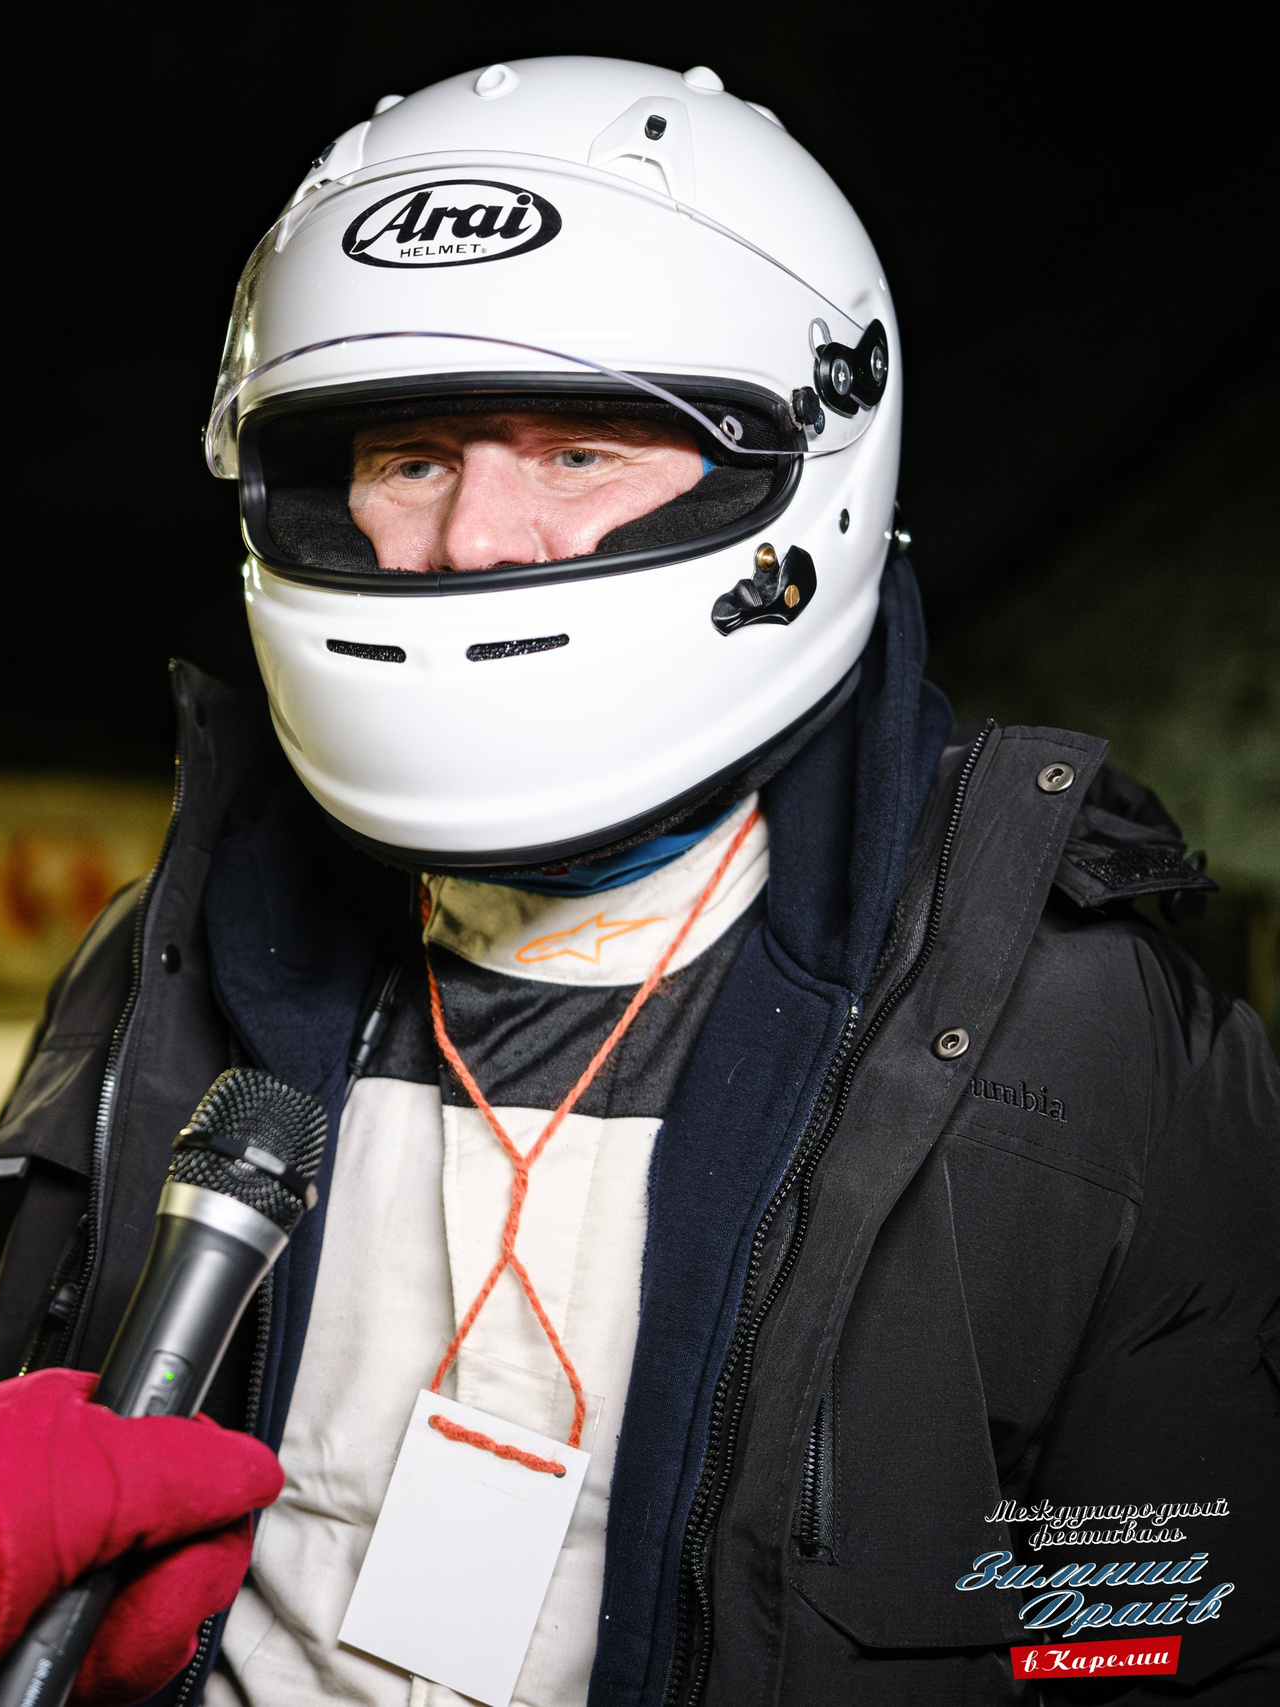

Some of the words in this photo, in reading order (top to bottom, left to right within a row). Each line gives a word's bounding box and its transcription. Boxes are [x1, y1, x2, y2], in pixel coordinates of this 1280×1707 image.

[350, 190, 533, 255] Arai
[400, 243, 481, 259] HELMET
[963, 1077, 1068, 1123] umbia
